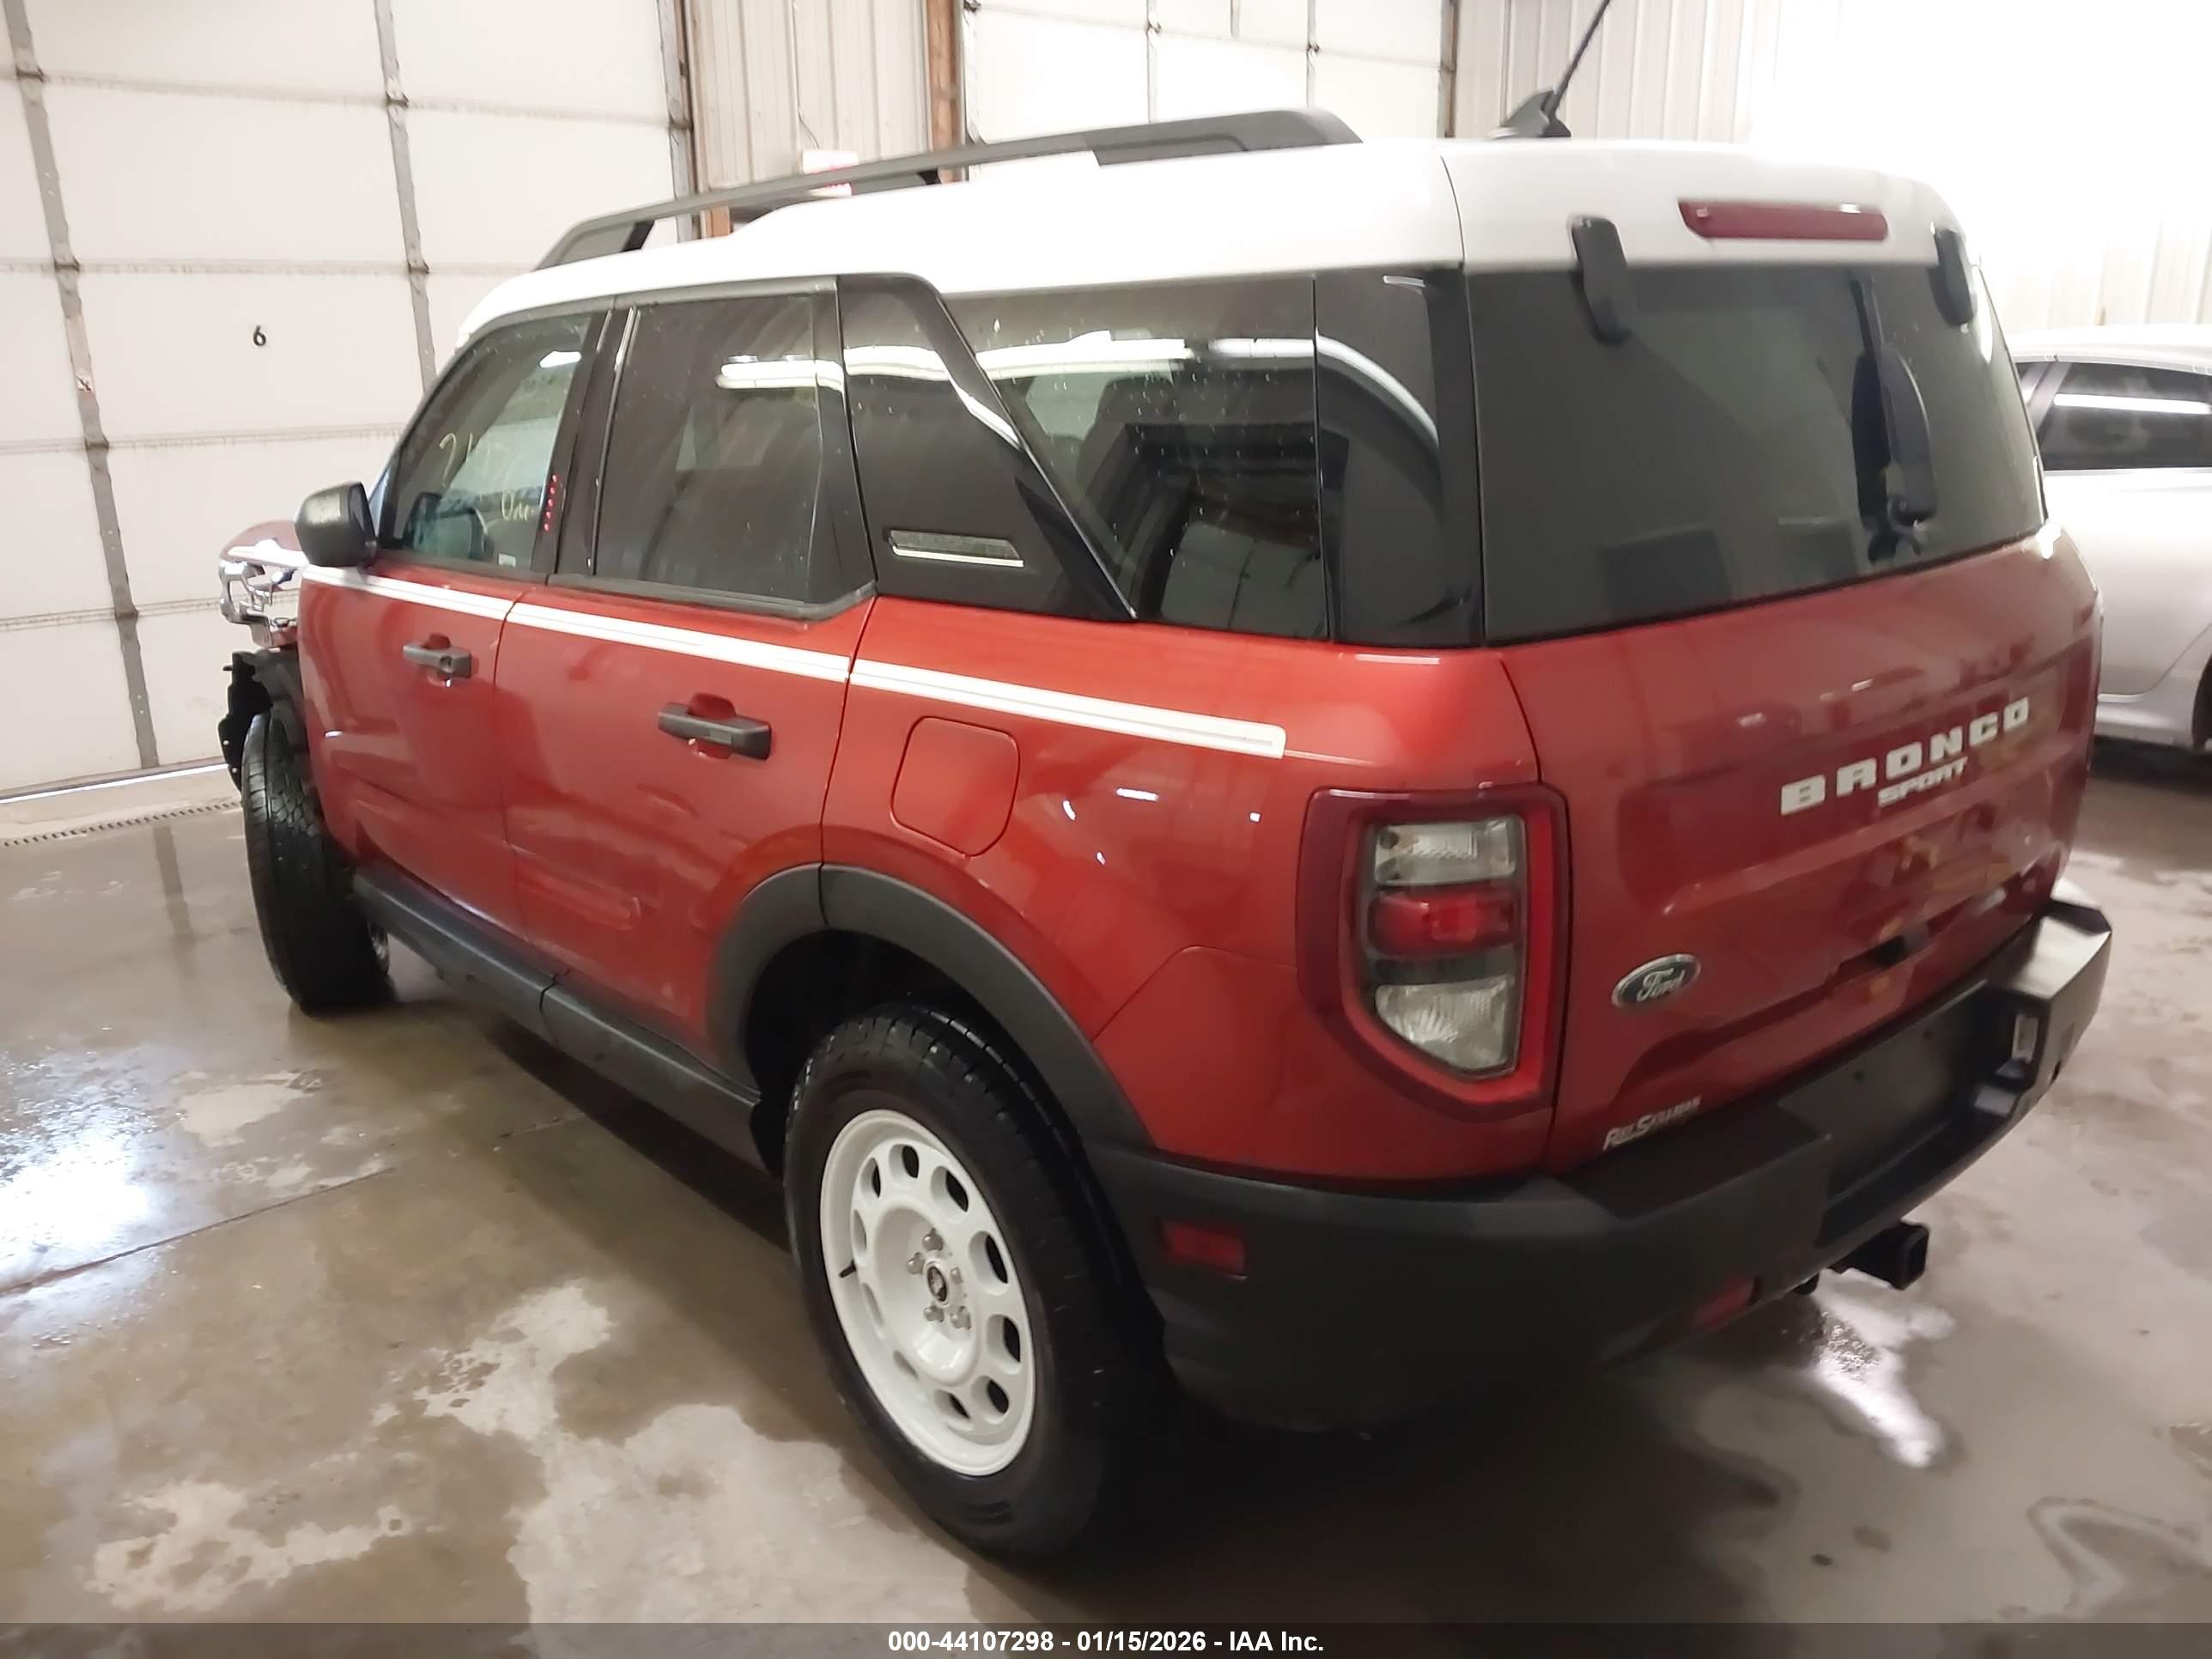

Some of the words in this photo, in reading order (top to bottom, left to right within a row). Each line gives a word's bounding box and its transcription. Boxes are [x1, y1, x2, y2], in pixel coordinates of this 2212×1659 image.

[252, 325, 267, 347] 6
[1780, 696, 2029, 817] BRONCO
[1877, 756, 1968, 807] SPORT
